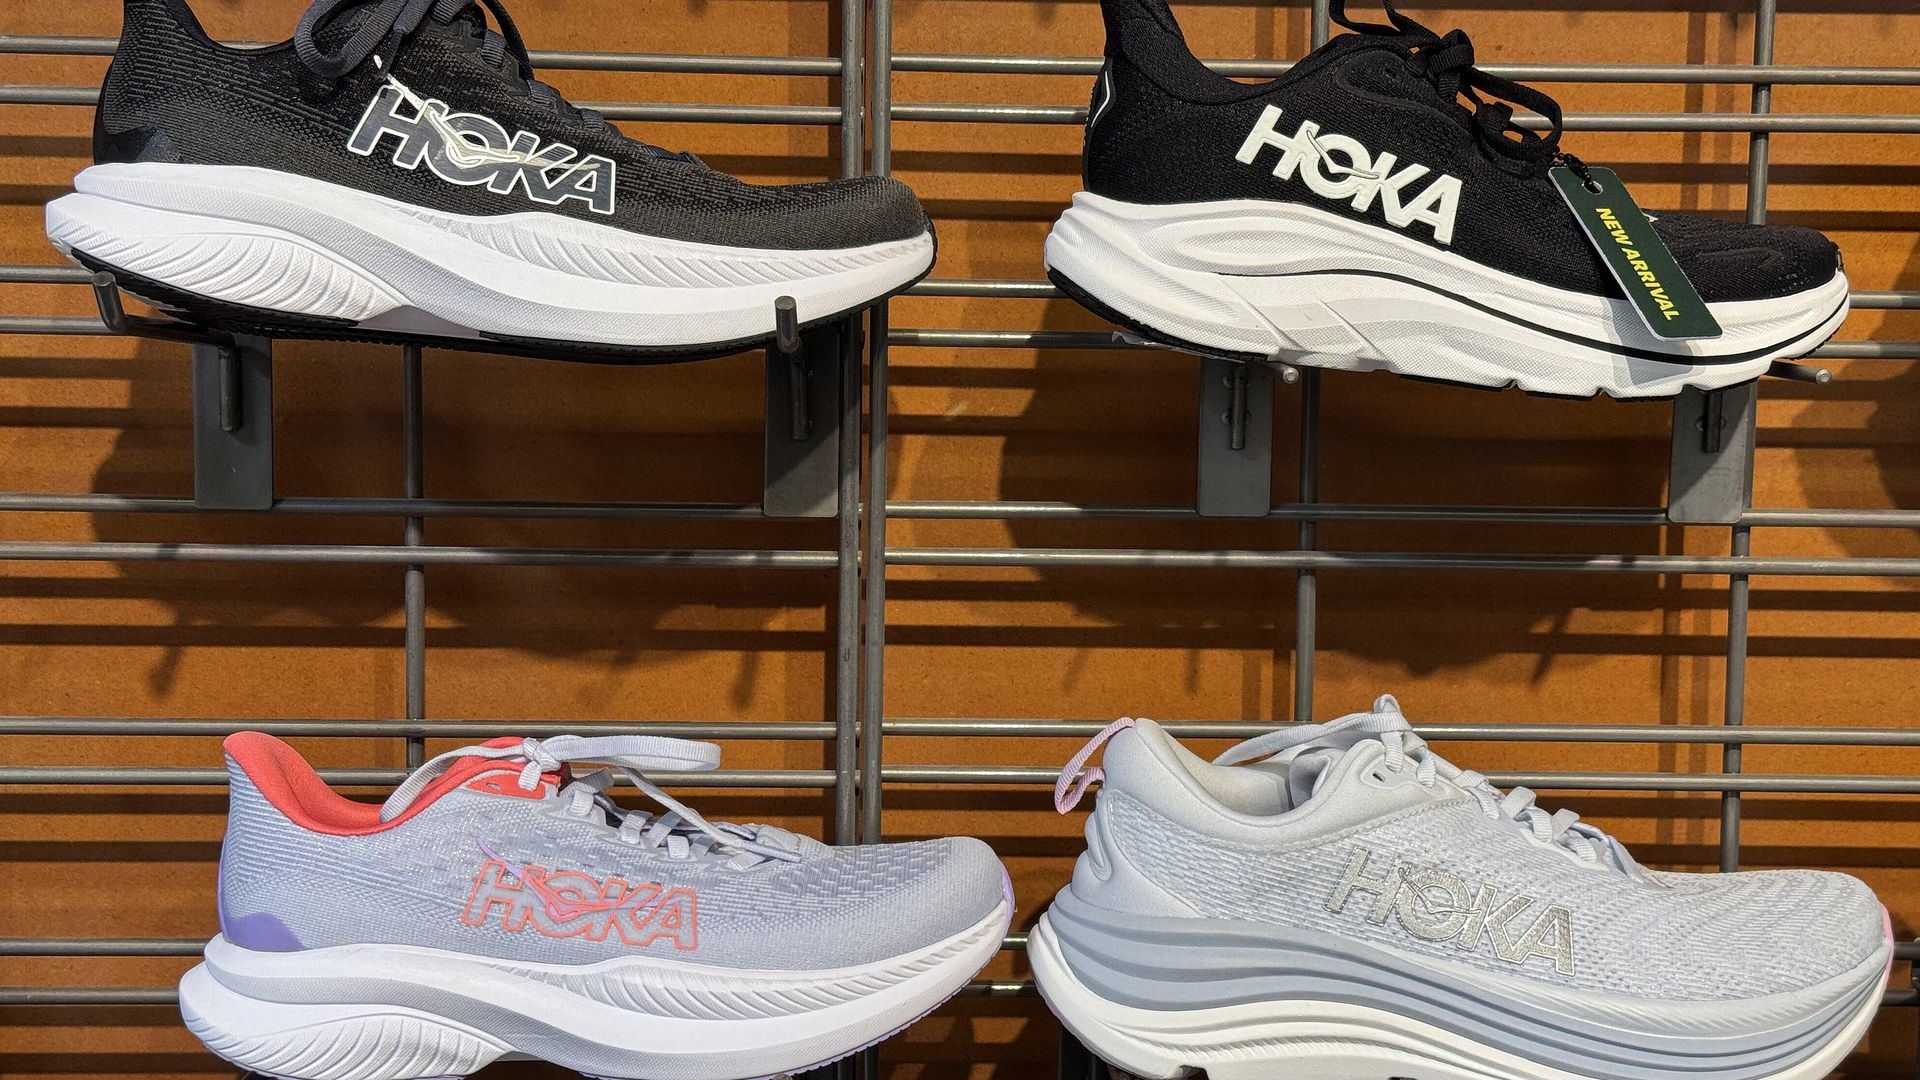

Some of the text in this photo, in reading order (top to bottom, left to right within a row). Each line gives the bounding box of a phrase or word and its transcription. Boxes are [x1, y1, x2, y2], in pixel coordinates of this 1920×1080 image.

[347, 84, 616, 215] HOKA
[1235, 104, 1462, 246] HOKA
[1595, 208, 1680, 321] NEW ARRIVAL
[461, 860, 698, 951] HOKA
[1323, 846, 1575, 976] HOKA
